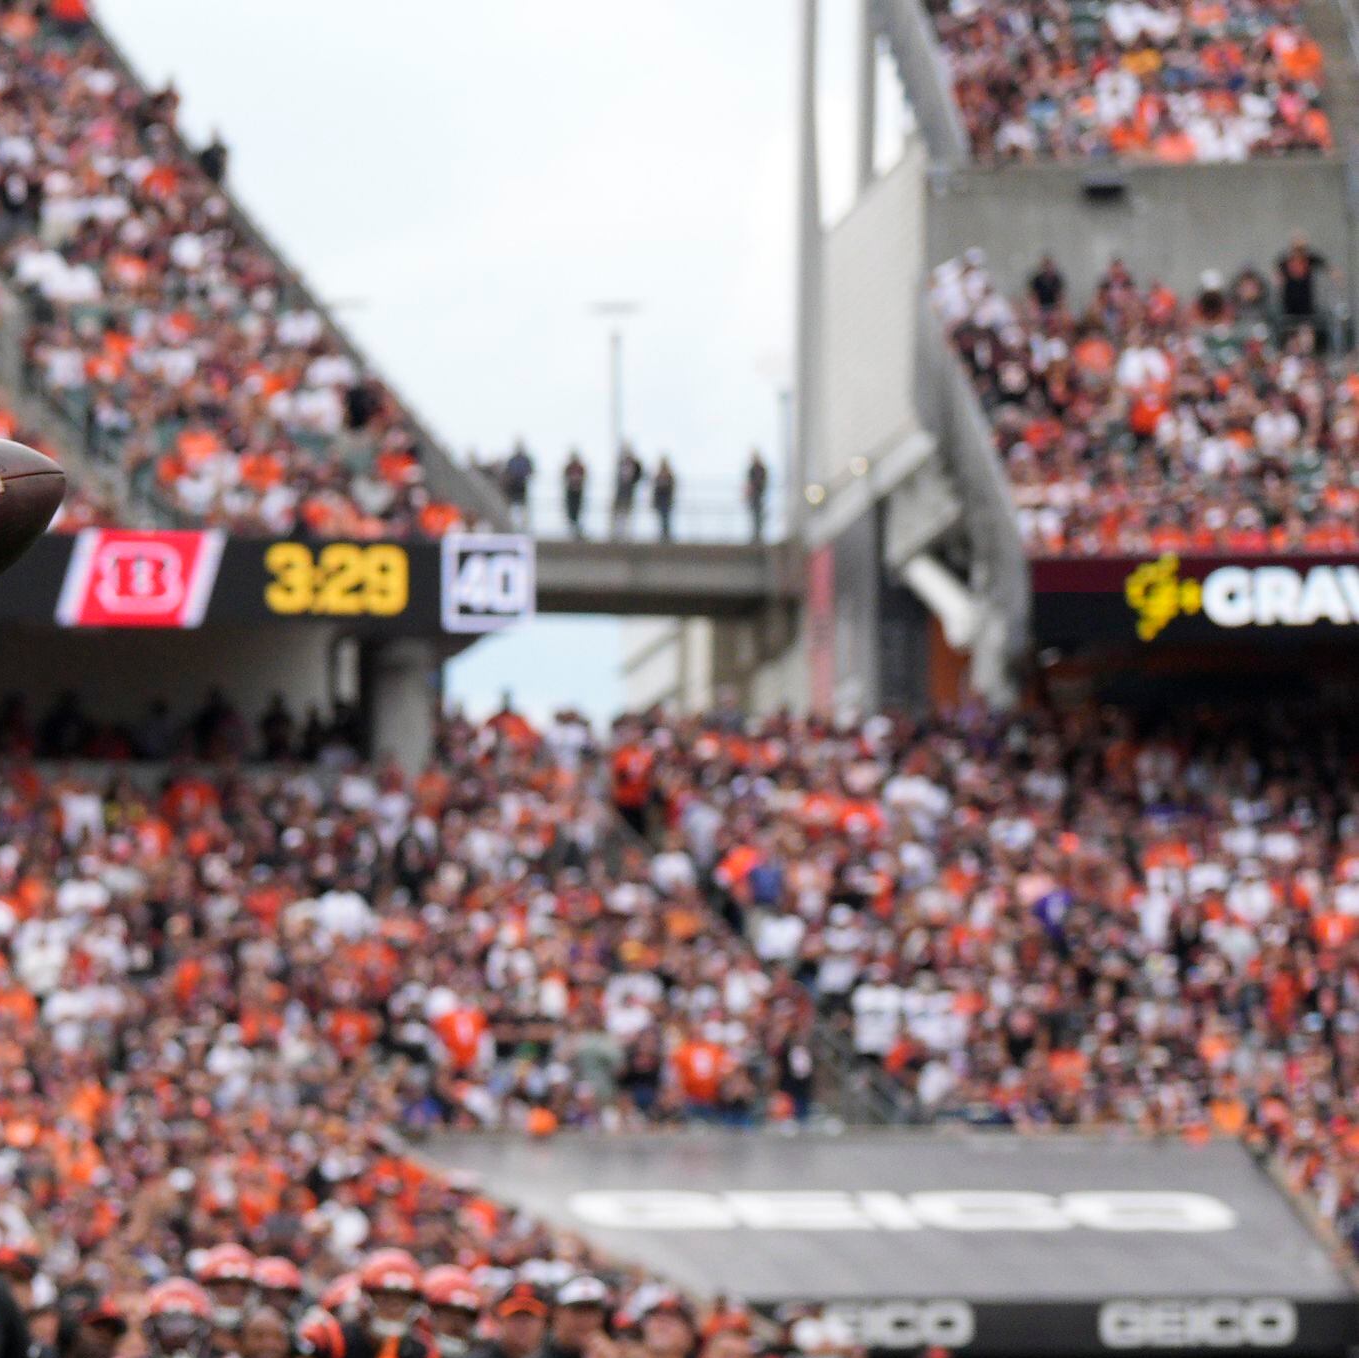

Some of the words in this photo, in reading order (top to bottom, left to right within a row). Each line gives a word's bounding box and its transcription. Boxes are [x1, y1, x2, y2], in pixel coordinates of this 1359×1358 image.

[263, 541, 410, 617] 3:29
[454, 551, 521, 616] 40
[572, 1190, 1237, 1233] GEICO
[825, 1300, 975, 1349] EICO
[1100, 1299, 1297, 1350] GEICO
